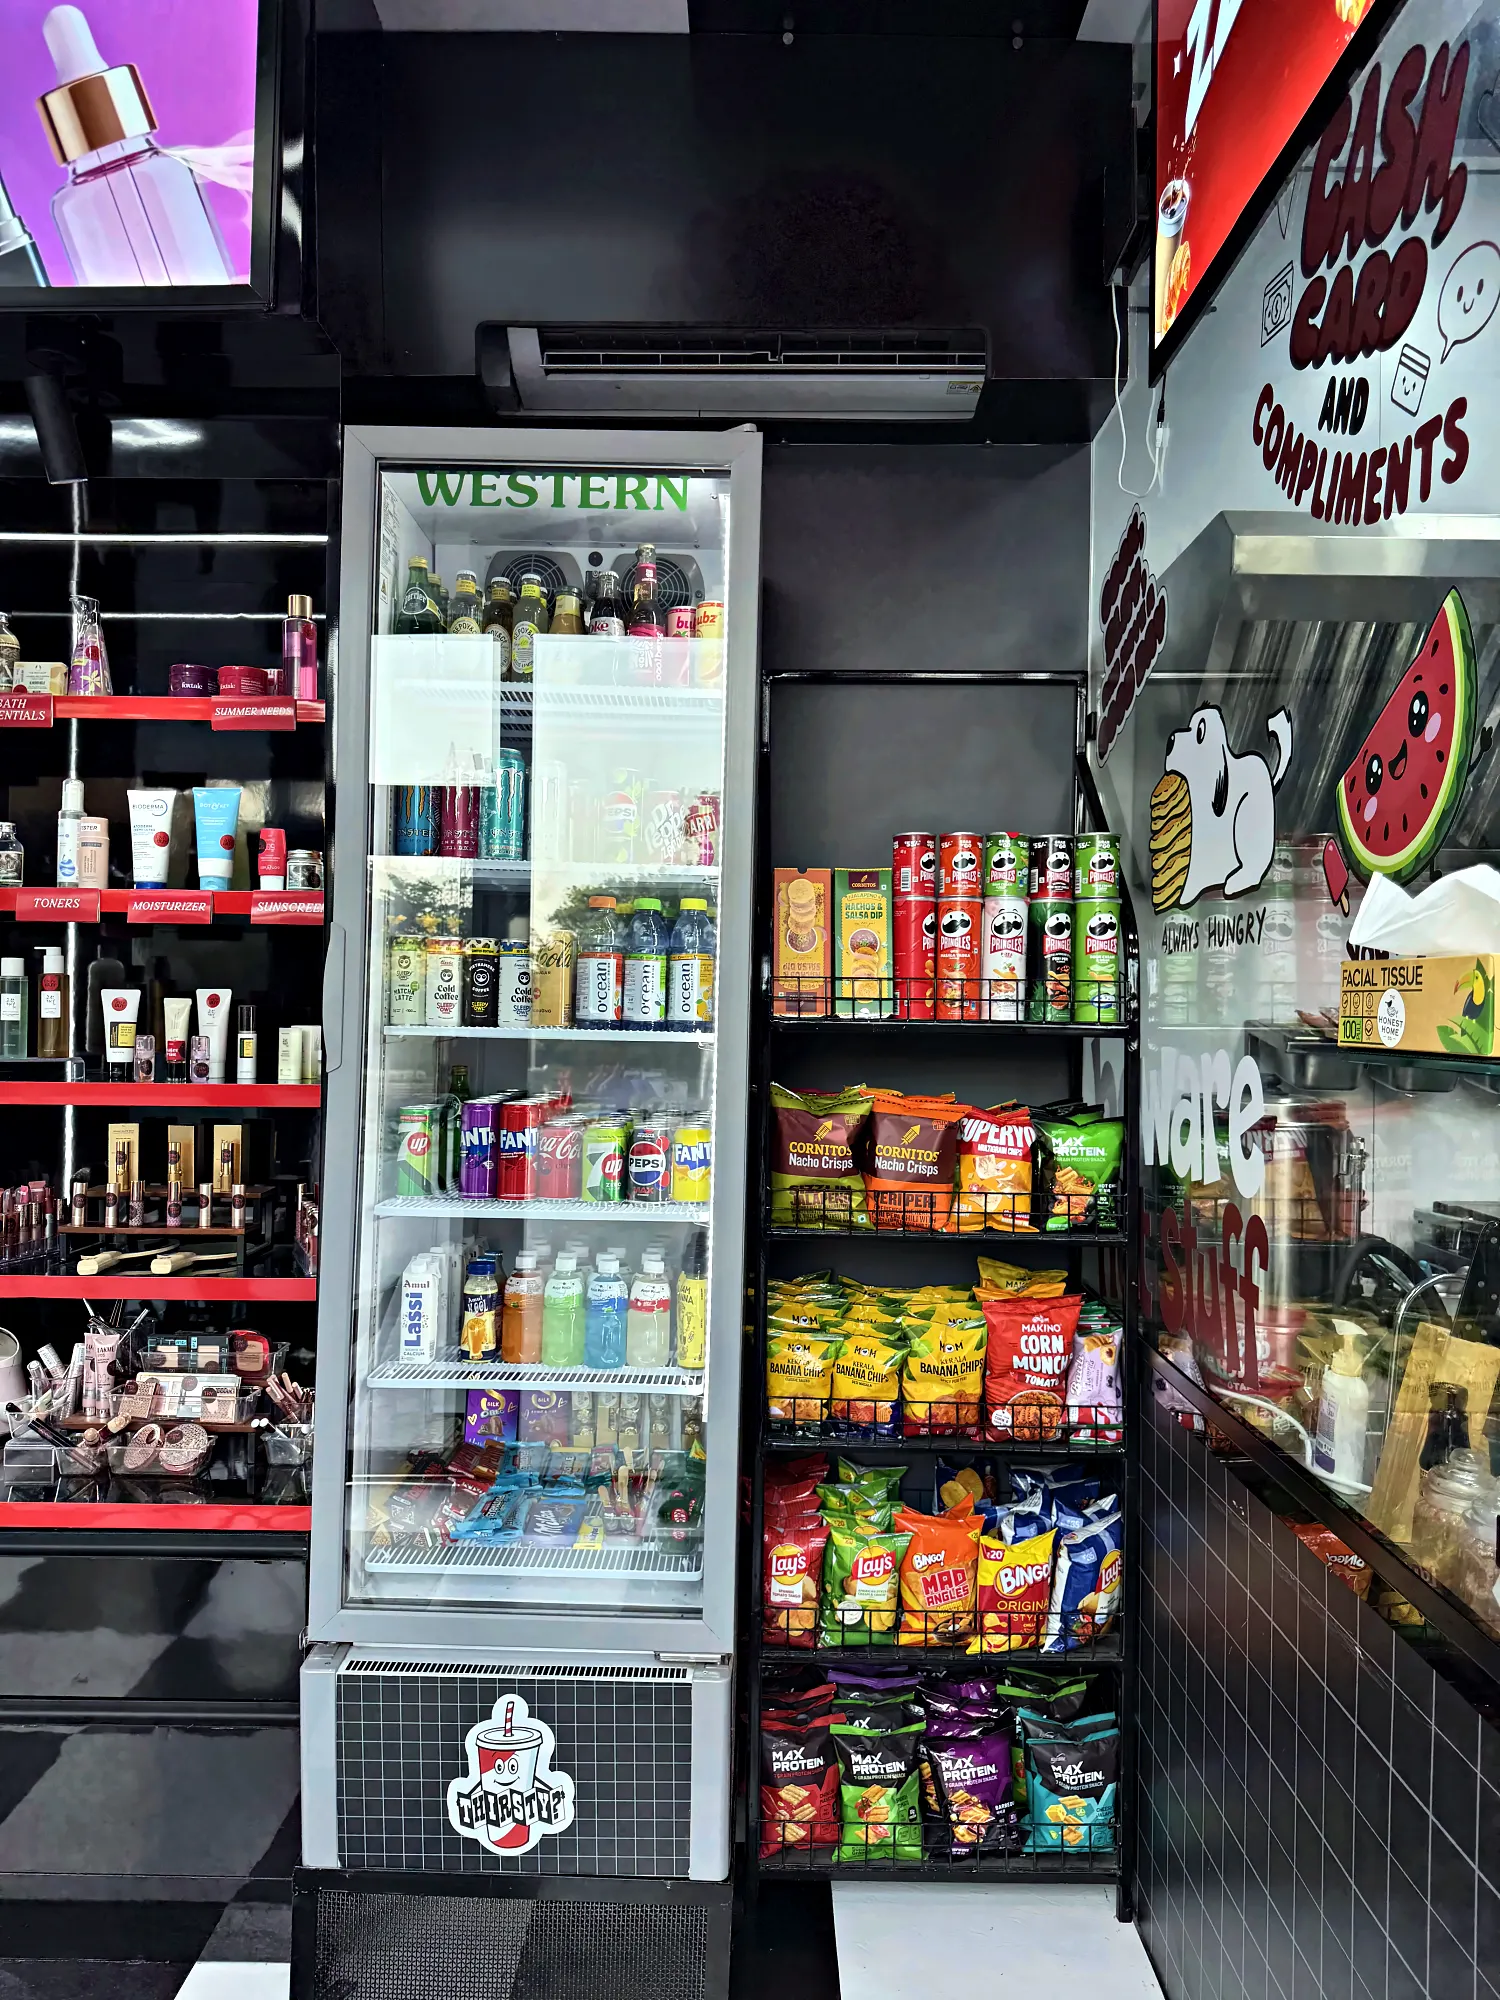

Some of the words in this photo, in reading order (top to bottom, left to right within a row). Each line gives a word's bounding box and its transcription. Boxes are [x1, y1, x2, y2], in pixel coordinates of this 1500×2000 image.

[1289, 236, 1428, 372] CARD
[1318, 376, 1369, 435] AND
[1253, 383, 1469, 528] COMPLIMENTS
[415, 470, 691, 511] WESTERN
[181, 682, 203, 690] foxtale
[215, 707, 257, 716] SUMMER
[260, 707, 293, 716] NEEDS
[952, 871, 977, 882] PRINGLES
[991, 871, 1015, 882] PRINGLES
[1046, 870, 1070, 882] PRINGLES
[1089, 871, 1115, 883] PRINGLES
[34, 898, 80, 909] TONERS
[132, 902, 207, 911] MOISTURIZER
[845, 903, 876, 911] NACHOS
[877, 903, 883, 911] &
[845, 911, 869, 919] SALSA
[870, 911, 883, 919] DIP
[1161, 921, 1199, 953] ALWAYS
[1207, 906, 1266, 949] HUNGRY
[940, 935, 971, 950] PRINGLES
[991, 937, 1022, 952] PRINGLES
[1087, 937, 1117, 953] PRINGLES
[1342, 968, 1378, 987] FACIAL
[1381, 965, 1423, 987] TISSUE
[434, 992, 459, 1001] Coffee
[437, 985, 456, 993] Cold
[515, 987, 532, 995] Cold
[436, 1002, 457, 1010] SLEEPY
[1343, 1020, 1357, 1039] 100
[1379, 1016, 1403, 1028] HONEST
[1382, 1026, 1399, 1037] HOME
[789, 1141, 852, 1157] CORNITOS
[1052, 1136, 1085, 1147] MAX
[875, 1145, 939, 1162] CORNITOS
[977, 1144, 1006, 1154] MULTIGRAIN
[1008, 1147, 1023, 1157] CHIPS
[1053, 1146, 1105, 1157] PROTEIN
[629, 1158, 665, 1168] PEPSI
[789, 1153, 819, 1168] Nacho
[821, 1156, 853, 1171] Crisps
[875, 1156, 905, 1172] Nacho
[907, 1160, 939, 1177] Crisps
[403, 1280, 430, 1289] Amul
[404, 1292, 423, 1347] Lassi
[1022, 1324, 1061, 1333] MAKINO
[1020, 1335, 1064, 1354] CORN
[852, 1361, 874, 1371] KERALA
[940, 1354, 966, 1364] KERALA
[1013, 1355, 1068, 1375] MUNCH
[770, 1362, 802, 1376] BANANA
[804, 1368, 826, 1378] CHIPS
[836, 1364, 865, 1380] BANANA
[868, 1371, 889, 1383] CHIPS
[920, 1362, 958, 1377] BANANA
[960, 1357, 984, 1374] CHIPS
[772, 1553, 807, 1577] Lay's
[857, 1555, 895, 1579] Lay's
[914, 1550, 945, 1570] BINGO!
[921, 1568, 968, 1595] MAD
[926, 1584, 970, 1607] ANGLES
[772, 1747, 805, 1762] MAX
[851, 1752, 883, 1765] MAX
[773, 1756, 824, 1772] PROTEIN
[853, 1761, 905, 1775] PROTEIN
[942, 1755, 974, 1771] MAX
[1051, 1761, 1083, 1776] MAX
[943, 1764, 996, 1782] PROTEIN
[966, 1778, 983, 1786] PROTEIN
[983, 1775, 998, 1783] SNACK
[1054, 1771, 1103, 1786] PROTEIN
[1088, 1781, 1103, 1789] SNACK
[457, 1790, 565, 1824] THIRSTY?
